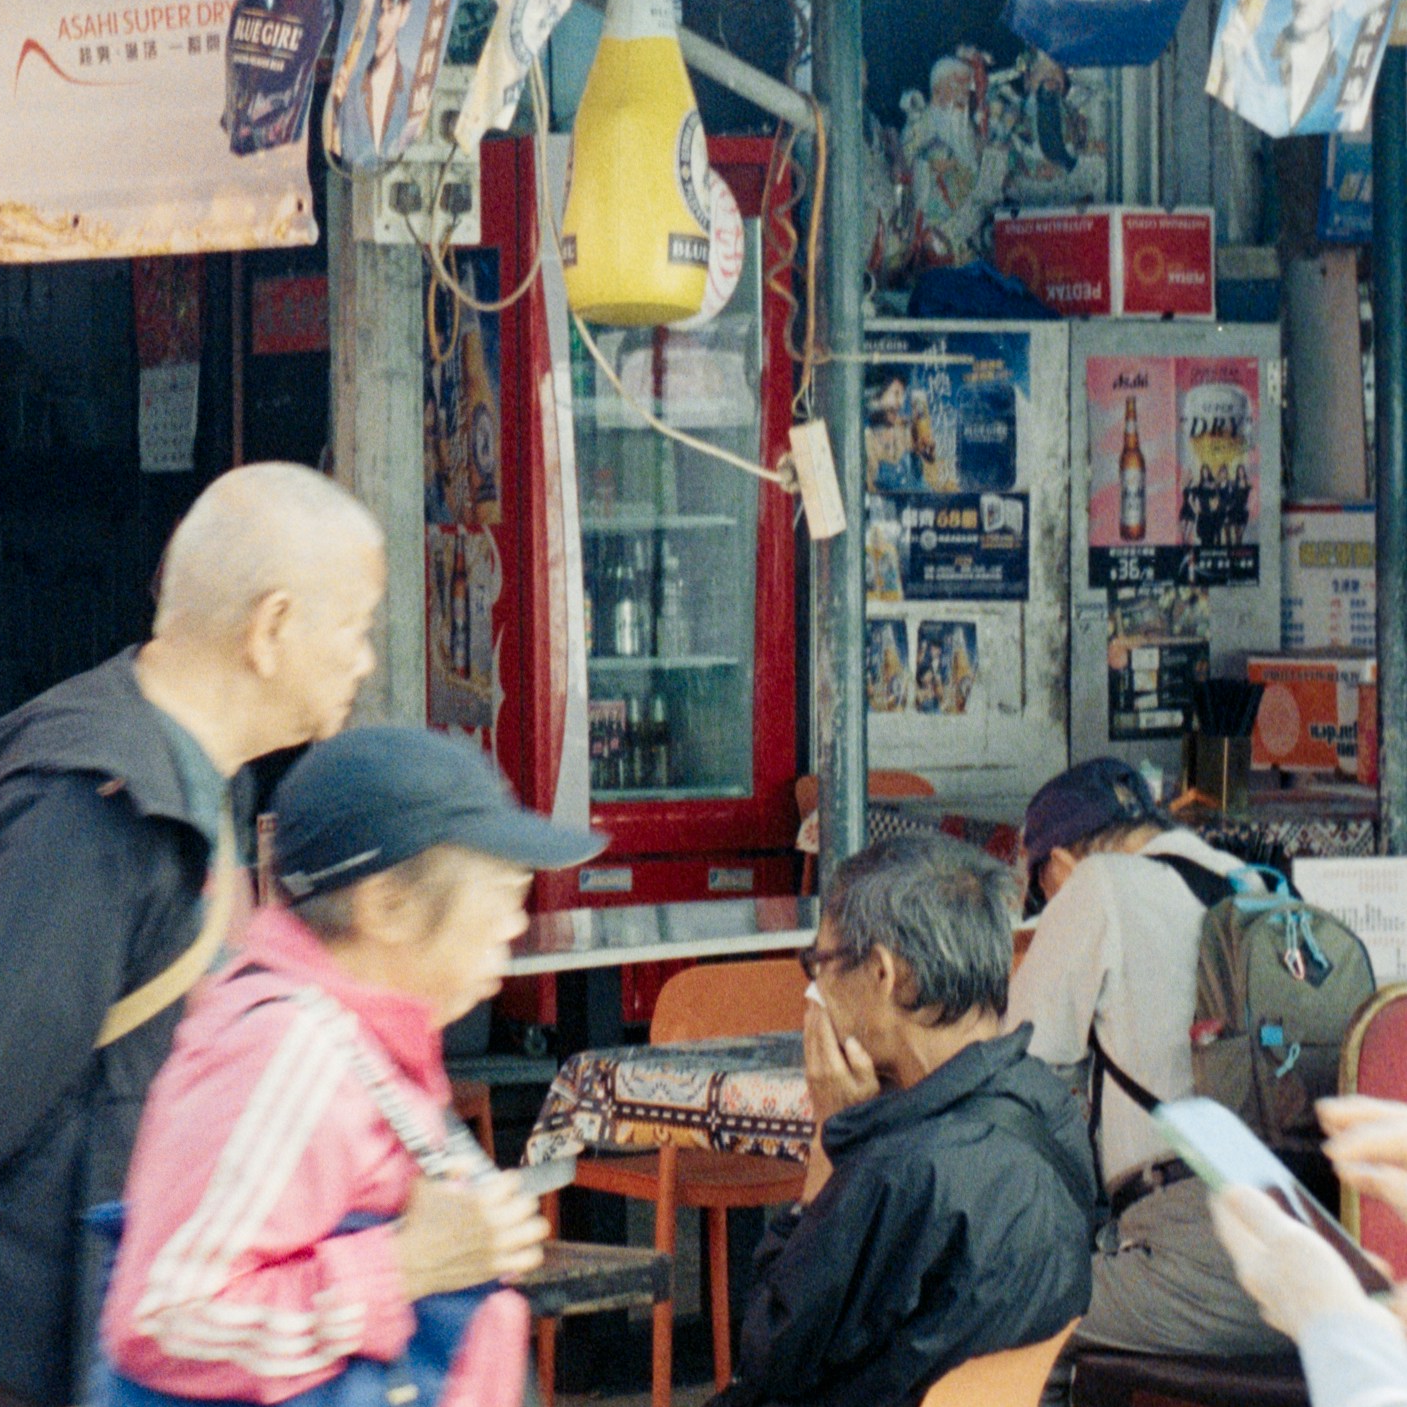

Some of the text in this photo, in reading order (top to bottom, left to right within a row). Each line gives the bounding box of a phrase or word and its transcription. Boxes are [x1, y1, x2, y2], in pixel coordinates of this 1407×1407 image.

[58, 12, 120, 41] ASAHI
[123, 5, 191, 36] SUPER
[262, 20, 304, 52] GIRL
